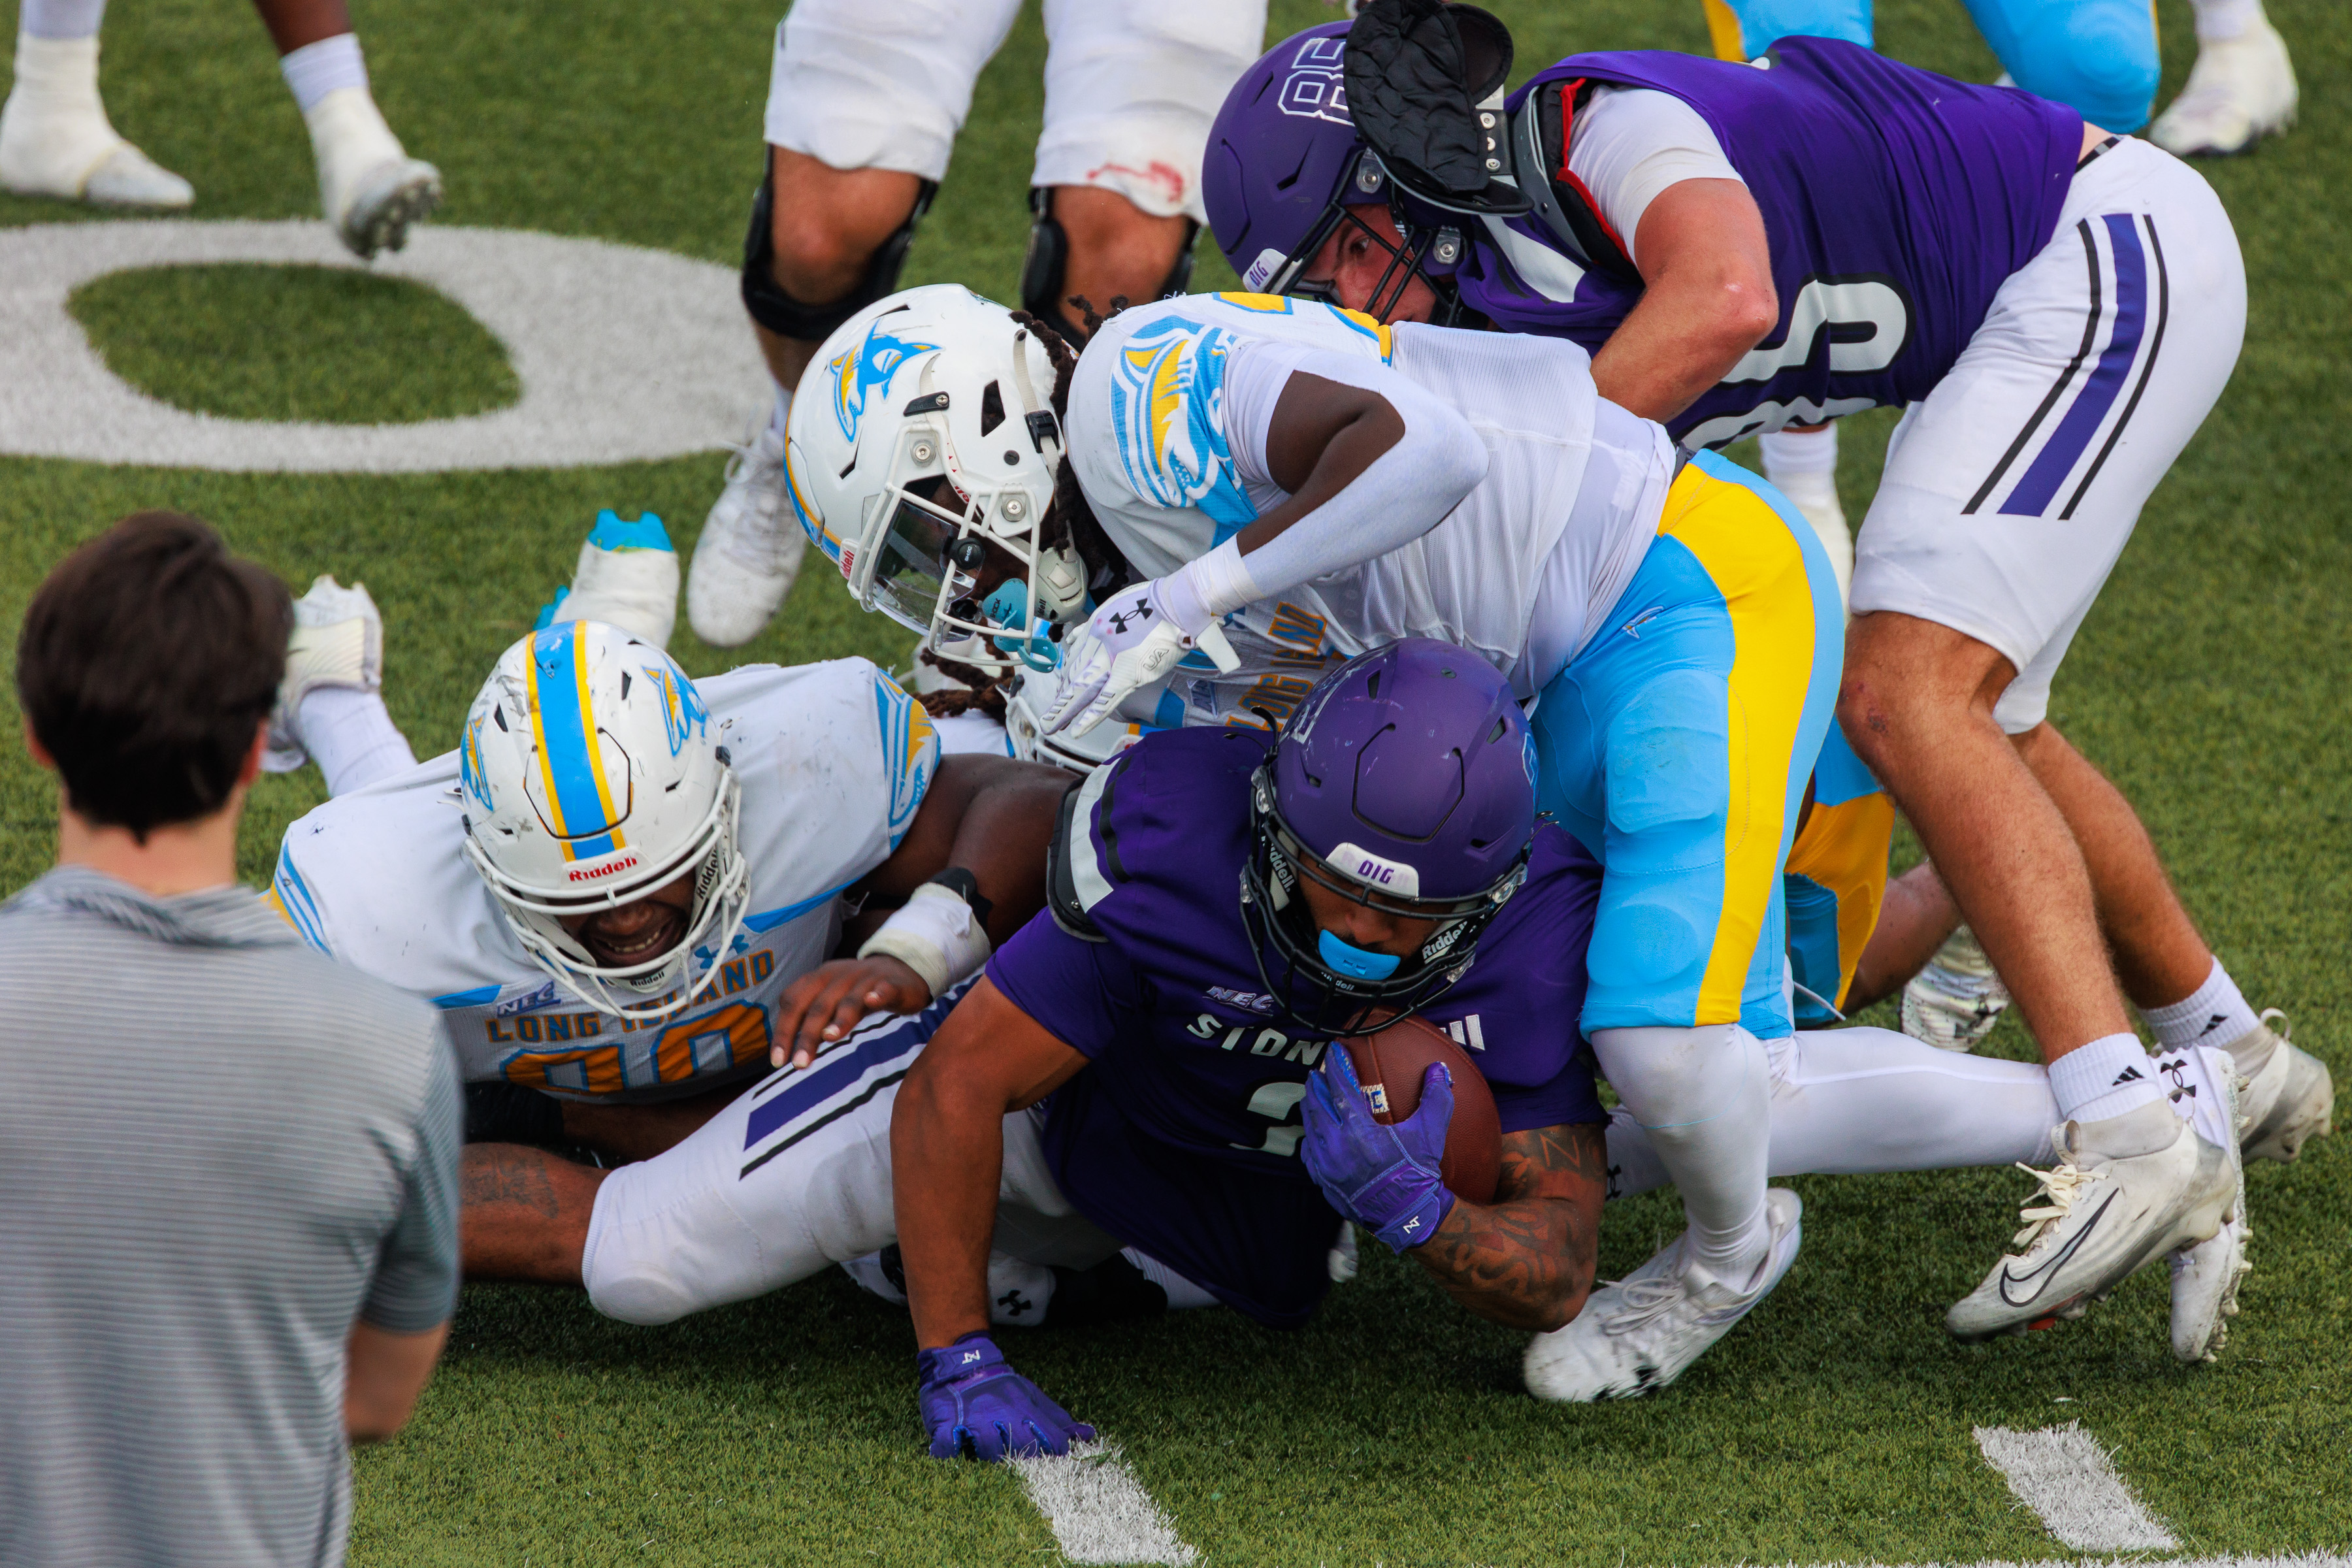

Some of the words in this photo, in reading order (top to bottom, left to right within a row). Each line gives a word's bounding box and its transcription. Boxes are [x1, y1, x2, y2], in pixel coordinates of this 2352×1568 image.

[1249, 260, 1269, 287] DIG
[568, 857, 638, 882] Riddell
[1357, 859, 1394, 885] DIG
[497, 982, 557, 1016] NEC
[1206, 985, 1275, 1013] NEC
[485, 1011, 602, 1043] LONG
